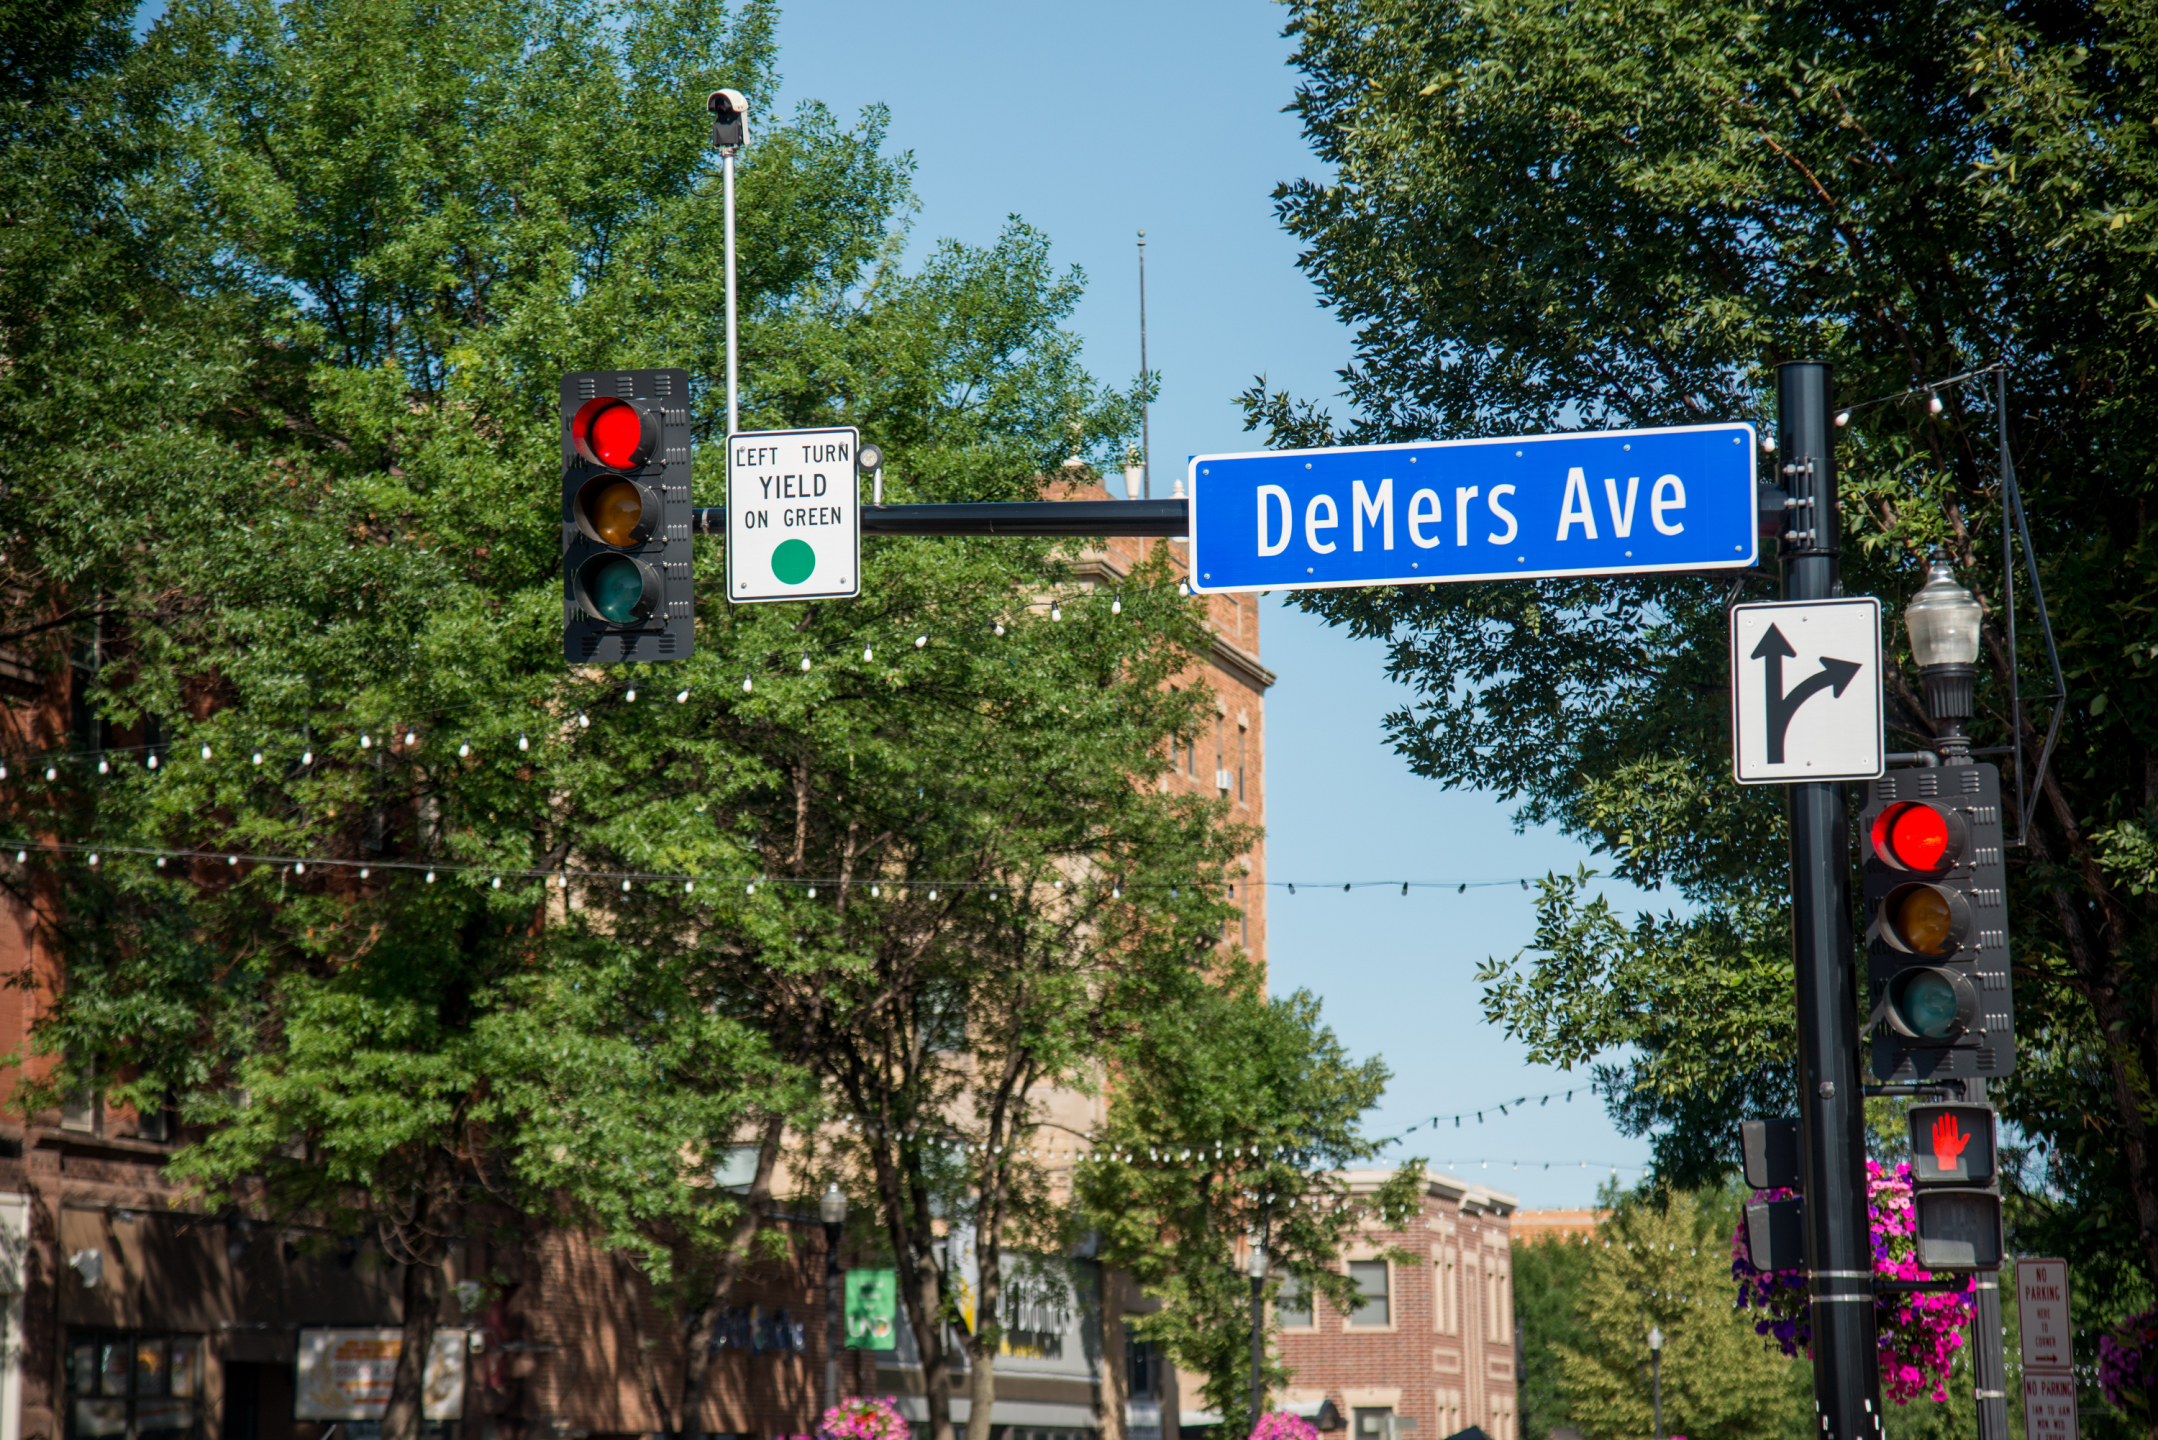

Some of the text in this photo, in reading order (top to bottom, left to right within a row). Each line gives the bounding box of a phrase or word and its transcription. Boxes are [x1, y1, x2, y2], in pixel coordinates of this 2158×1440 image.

[736, 443, 849, 467] LEFT TURN
[759, 473, 828, 500] YIELD
[744, 506, 842, 529] ON GREEN
[1256, 466, 1688, 558] DeMers Ave
[2036, 1267, 2047, 1284] NO
[2025, 1285, 2060, 1302] PARKING
[2037, 1307, 2051, 1320] HERE
[2041, 1321, 2049, 1334] TO
[2035, 1335, 2056, 1348] CORNER
[2026, 1380, 2073, 1398] NO PARKING
[2047, 1404, 2055, 1417] TO
